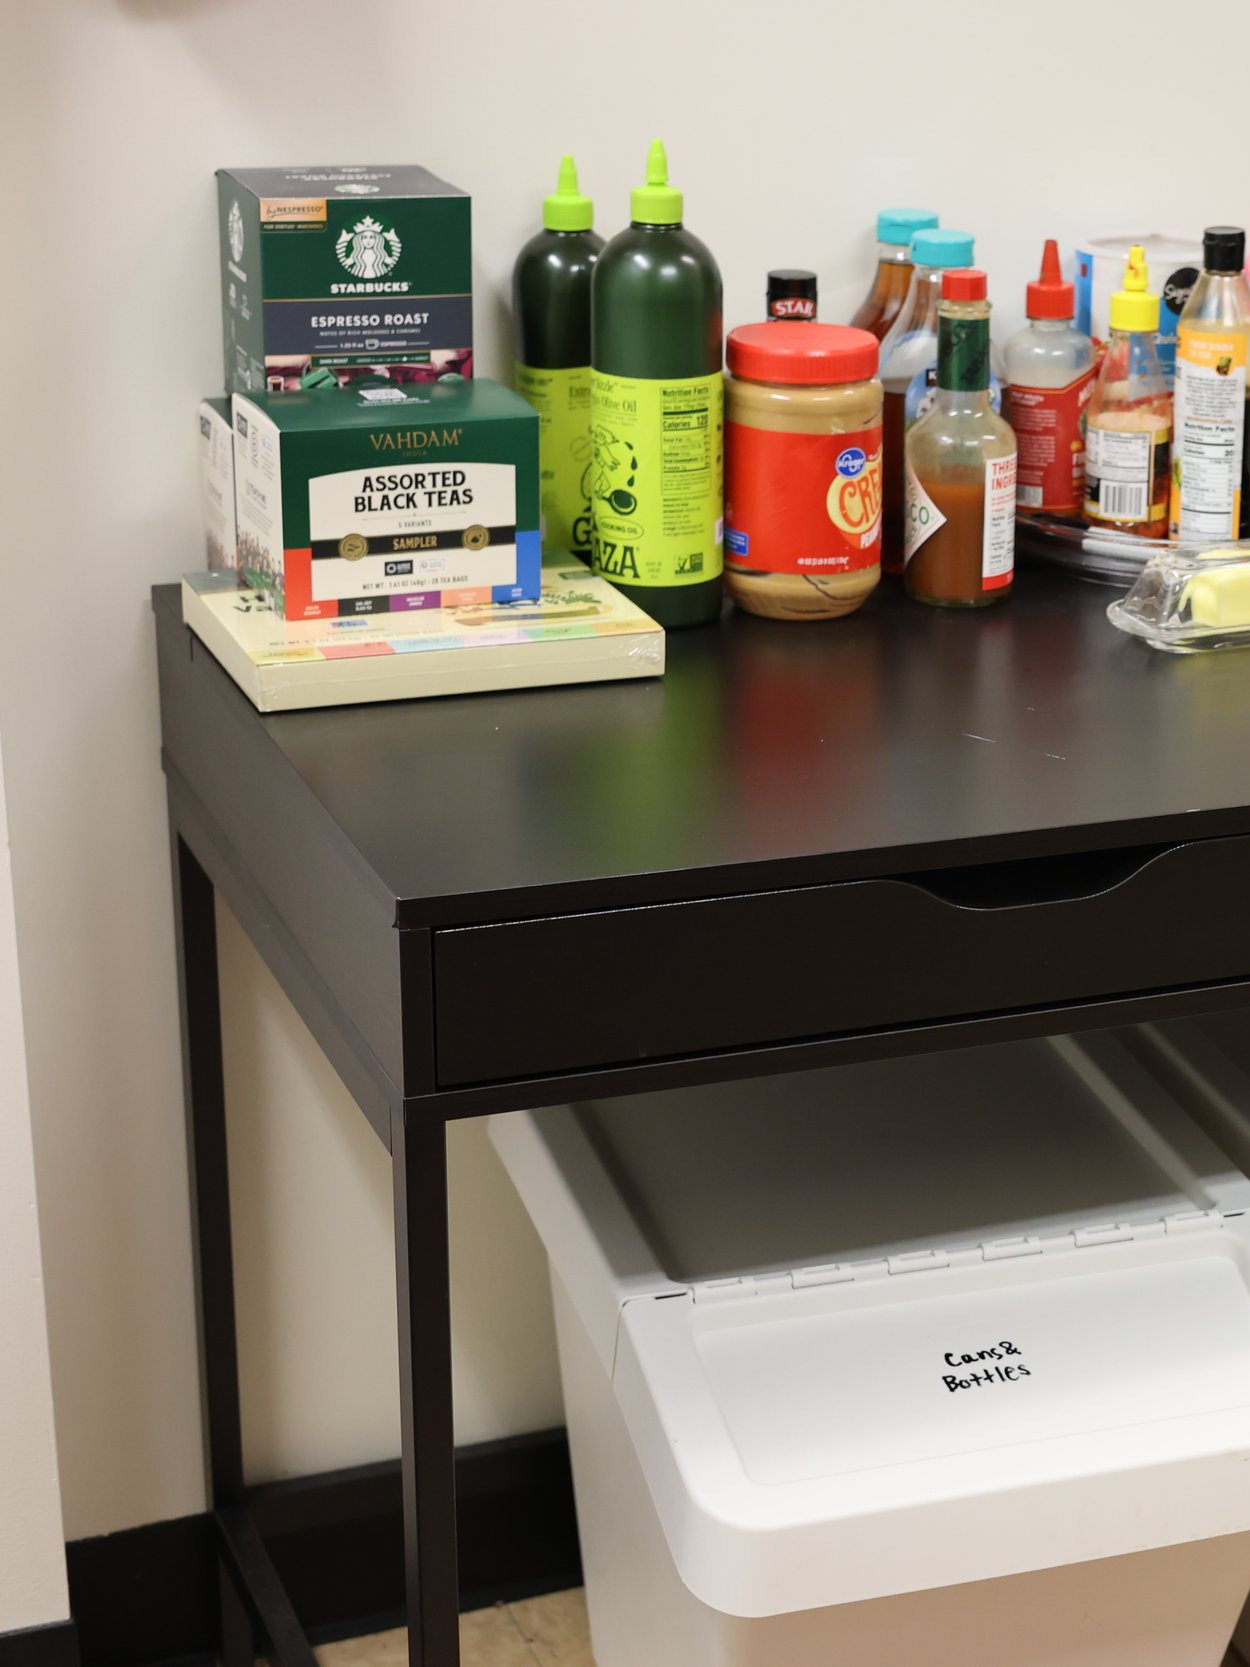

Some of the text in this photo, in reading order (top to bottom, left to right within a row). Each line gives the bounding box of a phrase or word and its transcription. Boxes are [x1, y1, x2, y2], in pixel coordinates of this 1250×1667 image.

[330, 281, 409, 294] STARBUCKS
[775, 300, 814, 317] STAR
[311, 313, 430, 328] ESPRESSO ROAST
[370, 429, 460, 450] VAHDAM
[838, 454, 866, 472] Kroger
[362, 470, 466, 493] ASSORTED
[354, 489, 474, 513] BLACK TEAS
[393, 535, 438, 550] SAMPLER
[941, 1364, 1031, 1392] Bottles
